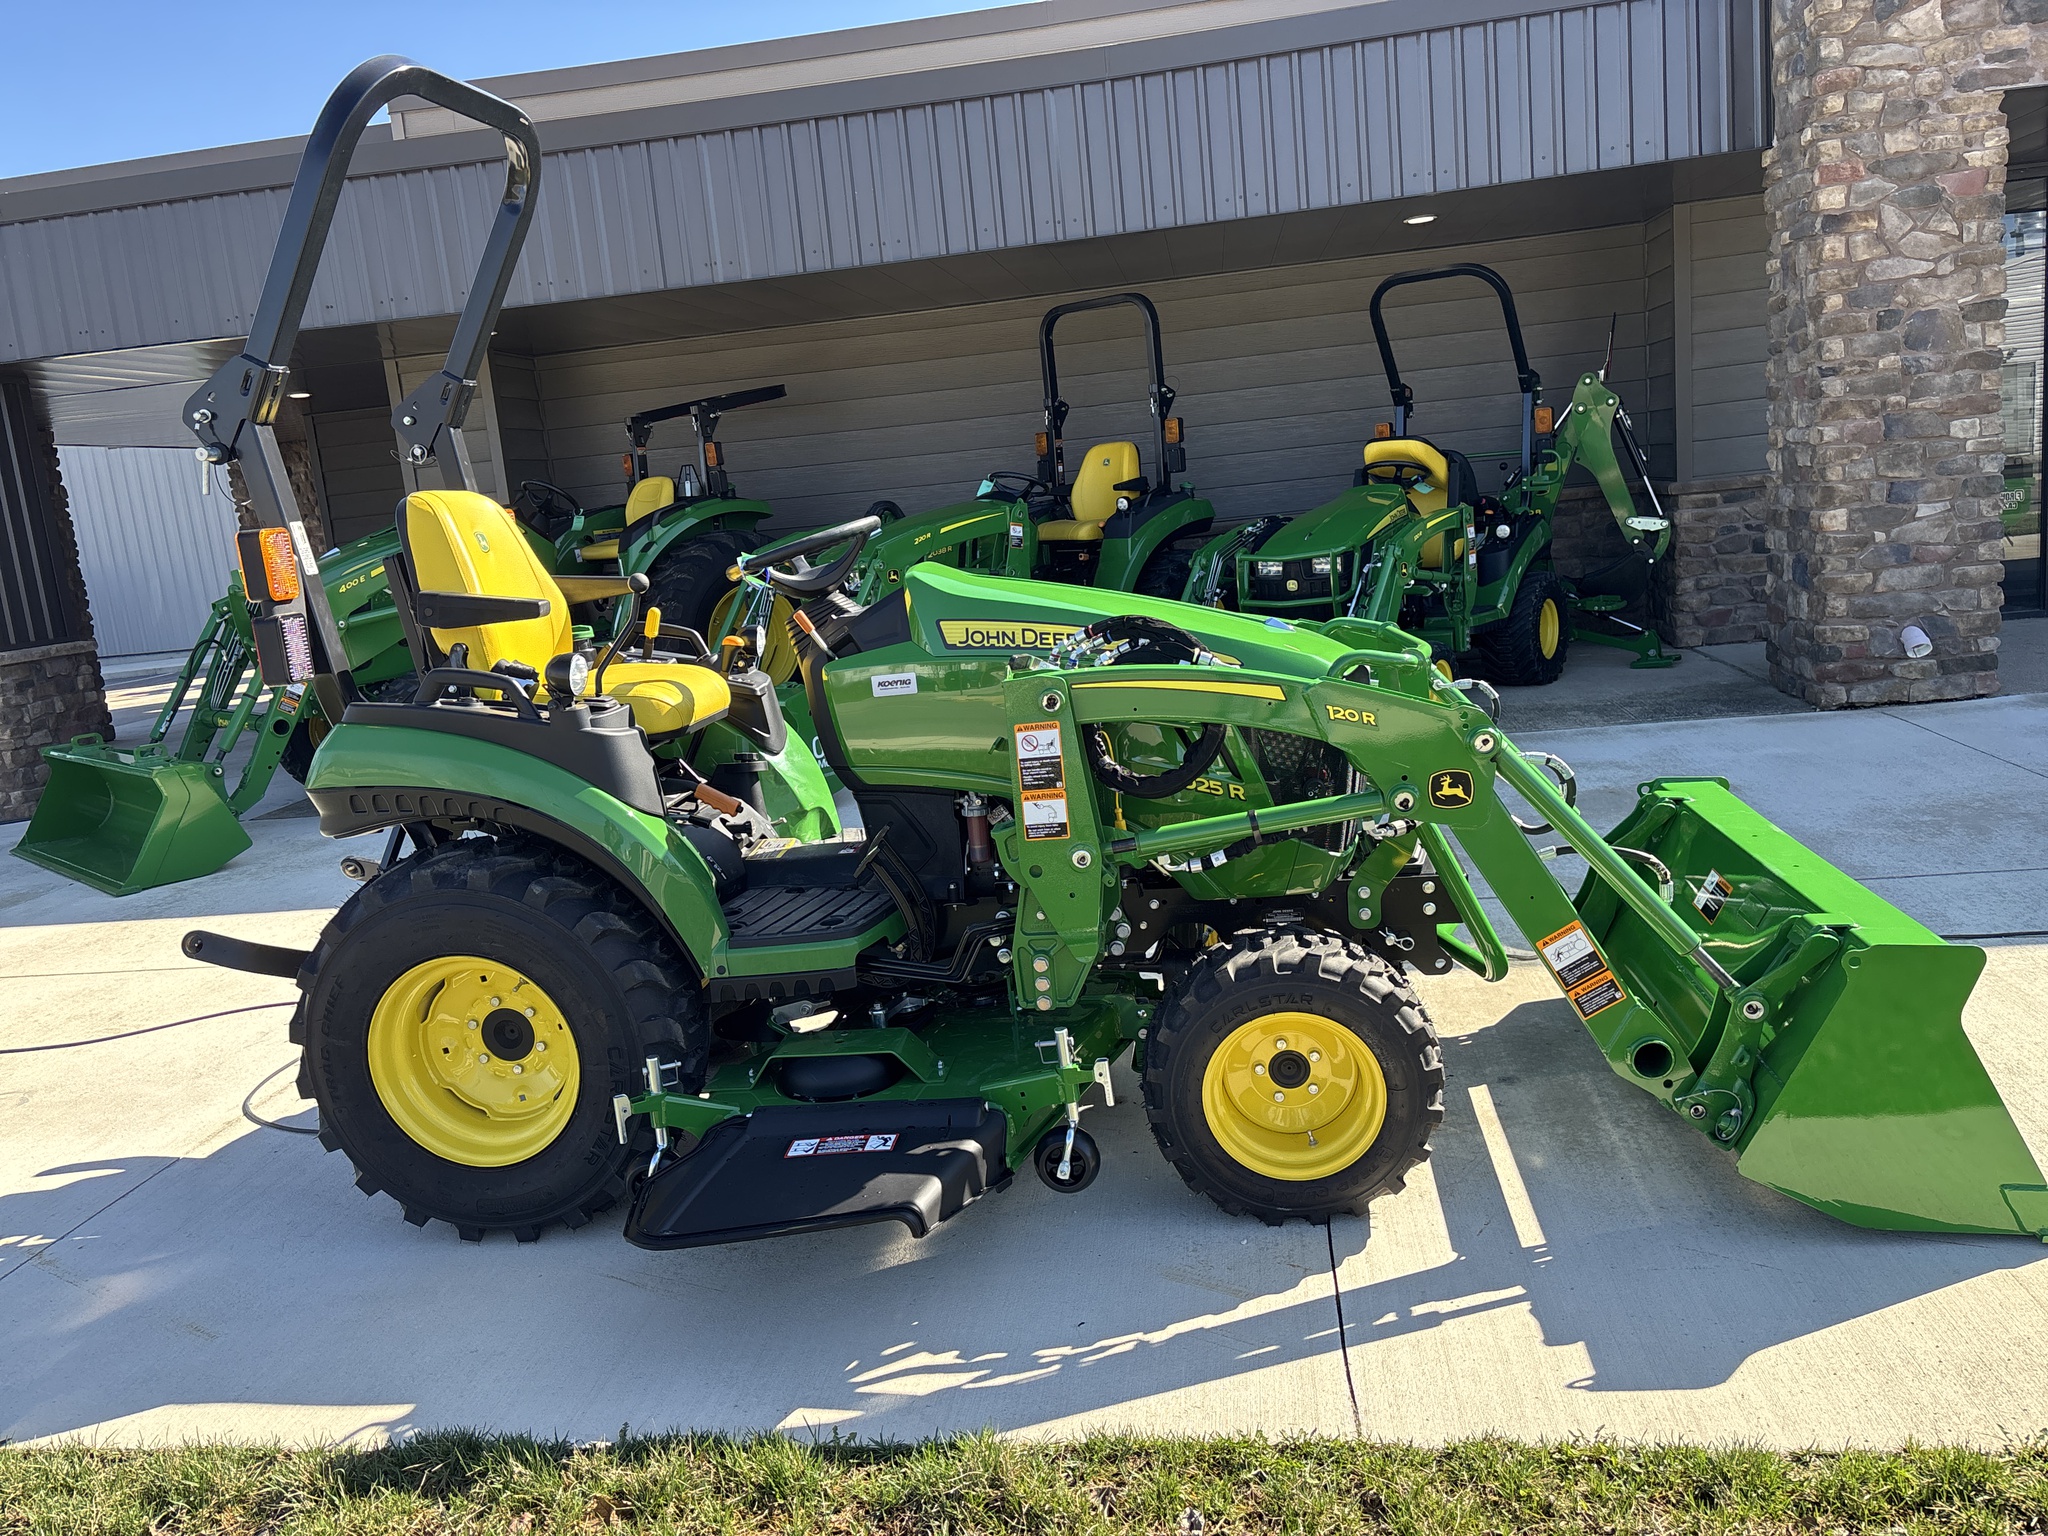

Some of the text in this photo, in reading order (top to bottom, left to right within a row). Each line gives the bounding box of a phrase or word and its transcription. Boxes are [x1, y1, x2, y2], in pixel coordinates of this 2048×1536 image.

[914, 536, 927, 545] 220
[339, 574, 367, 594] 400 E
[958, 627, 1076, 646] JOHN DEE
[1325, 704, 1377, 727] 120 R
[1023, 722, 1058, 731] WARNING
[1030, 791, 1064, 801] WARNING
[1227, 783, 1247, 801] R
[1548, 924, 1576, 942] WARNING
[1580, 975, 1608, 993] WARNING
[1210, 992, 1313, 1034] CARLSTAR
